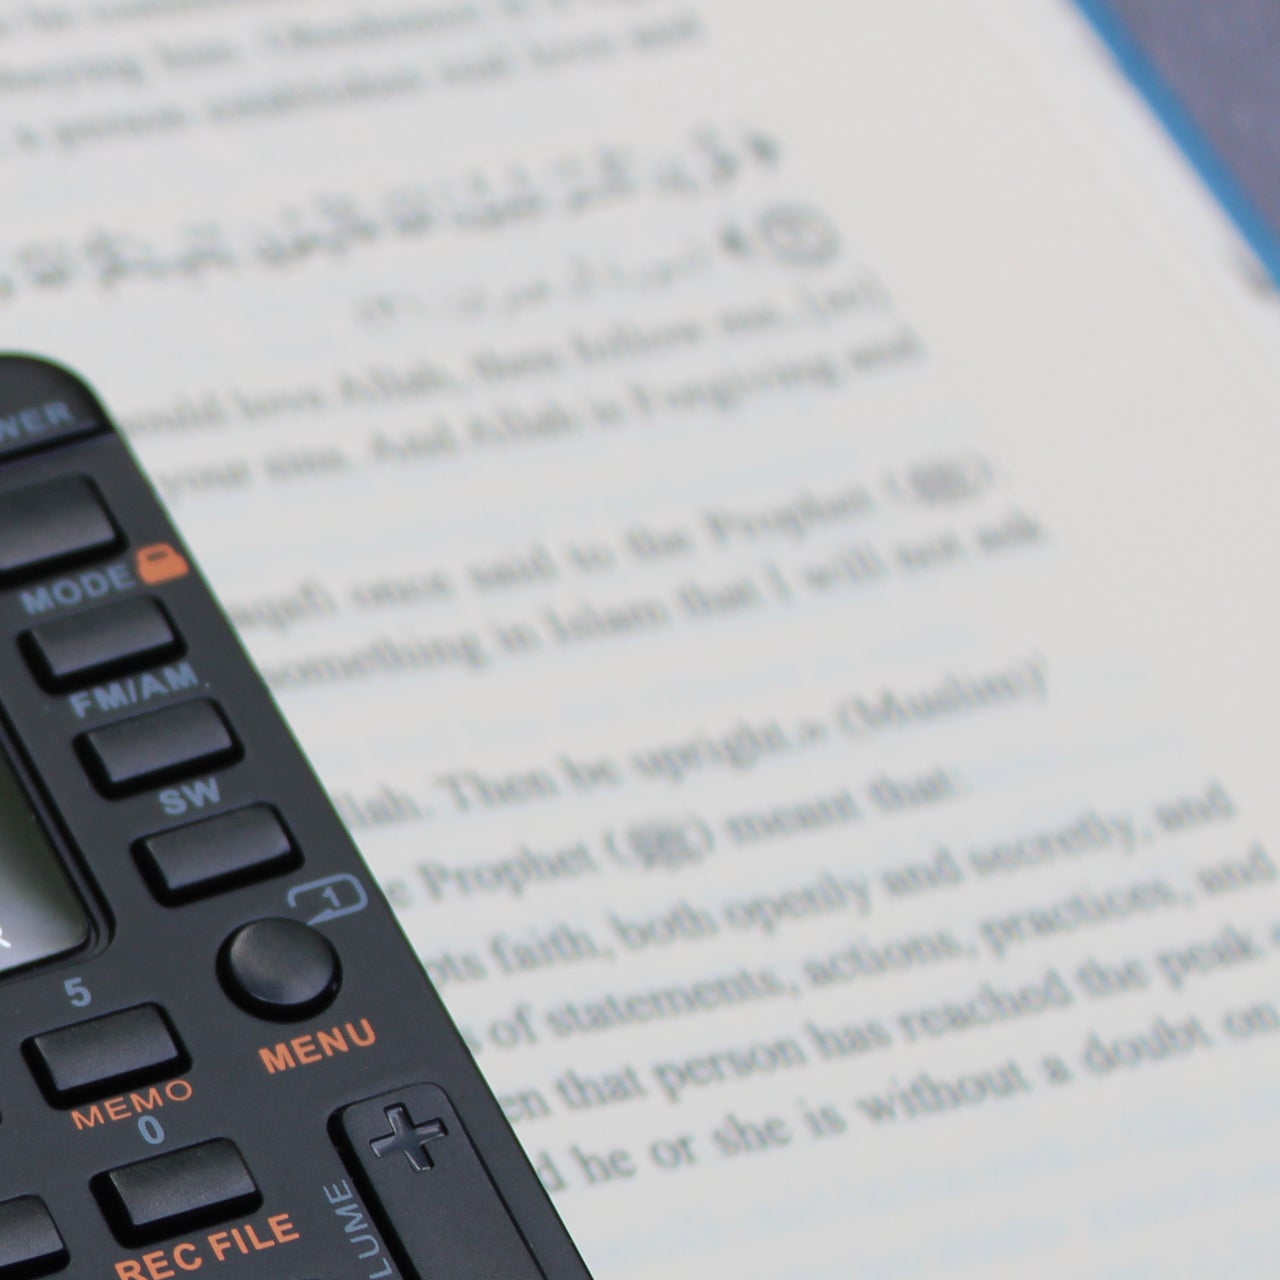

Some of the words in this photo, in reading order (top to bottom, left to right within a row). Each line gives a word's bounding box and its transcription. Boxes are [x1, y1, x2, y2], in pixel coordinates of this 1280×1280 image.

[20, 563, 136, 617] MODE
[69, 663, 199, 718] FM/AM
[159, 778, 221, 815] SW
[64, 976, 92, 1007] 5
[258, 1017, 377, 1075] MENU
[554, 1061, 650, 1111] that
[651, 1032, 808, 1107] person
[803, 1019, 894, 1062] has
[71, 1078, 193, 1131] MEMO
[569, 1140, 639, 1187] he
[649, 1134, 698, 1172] or
[711, 1112, 794, 1159] she
[796, 1096, 848, 1139] is
[854, 1058, 1032, 1126] without
[1042, 1054, 1073, 1086] a
[1081, 1013, 1212, 1076] doubt
[139, 1114, 165, 1145] 0
[208, 1213, 300, 1261] FILE
